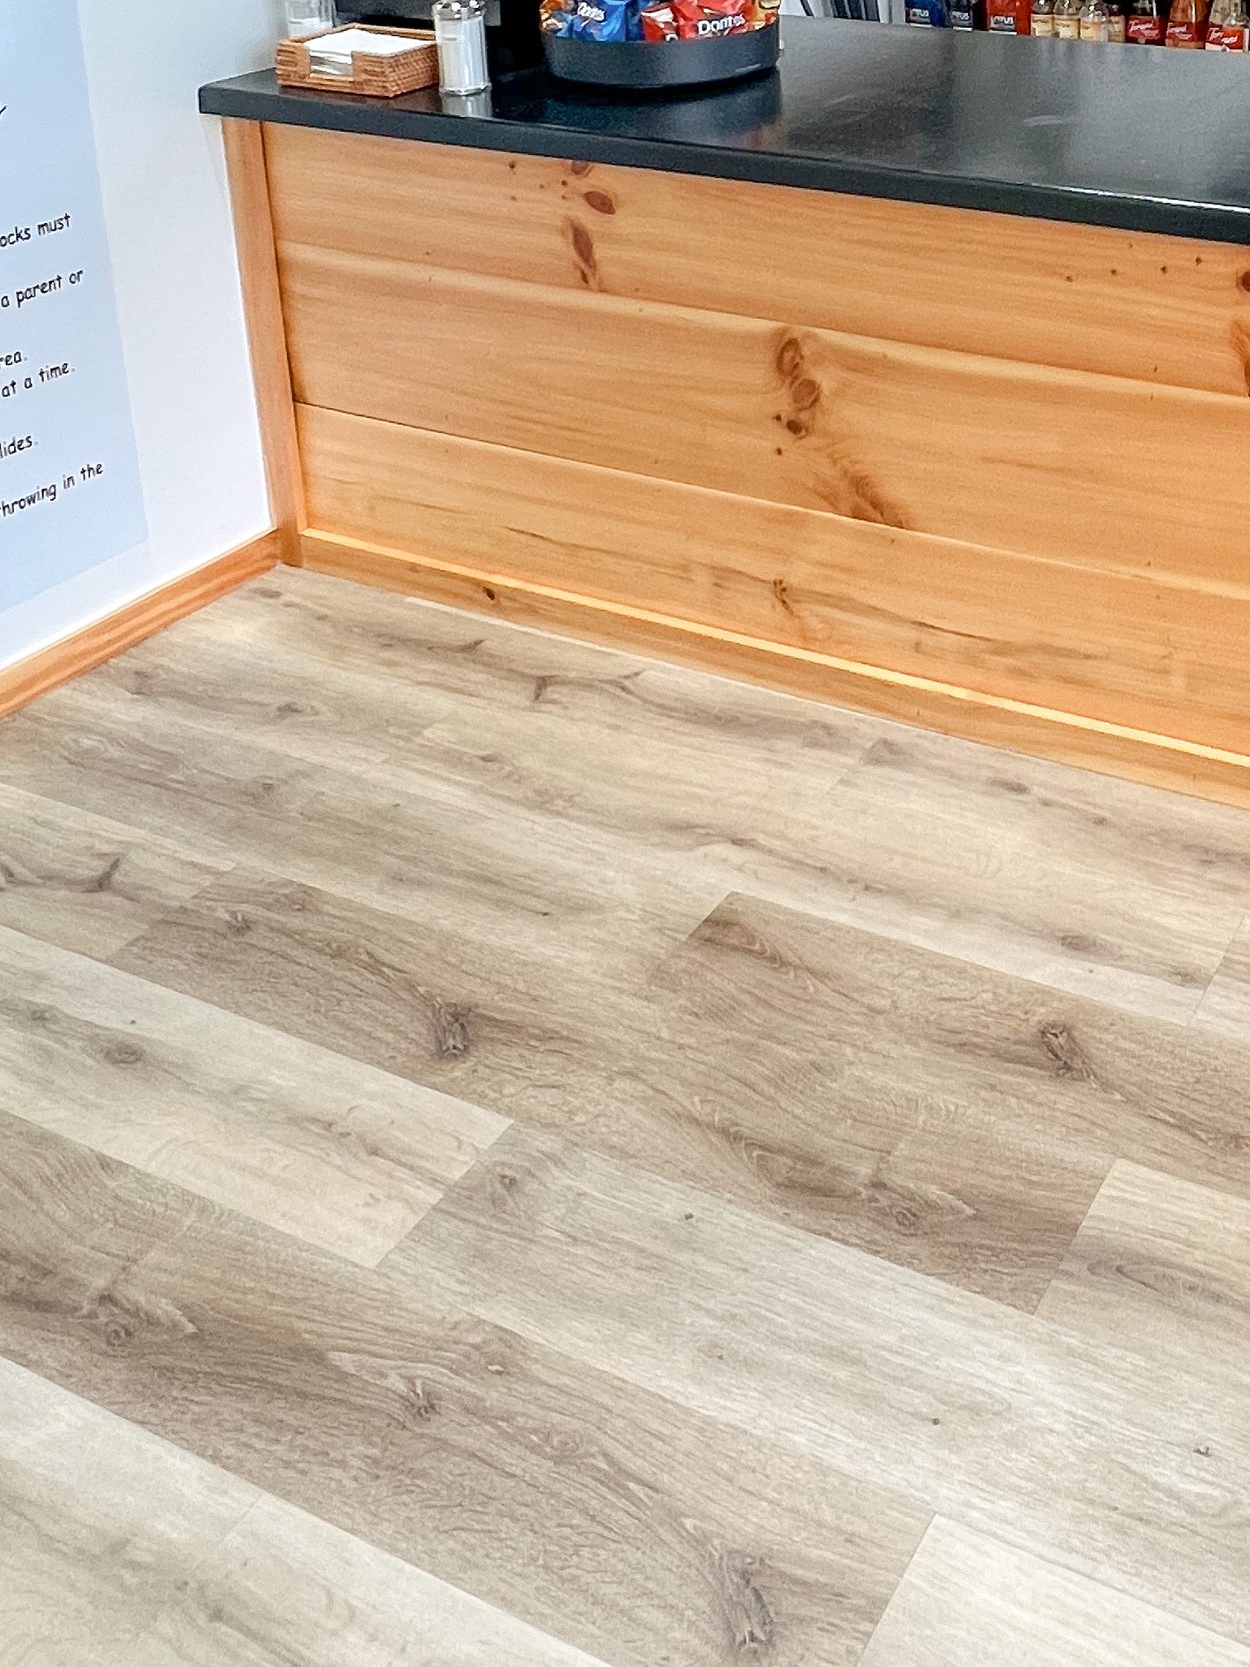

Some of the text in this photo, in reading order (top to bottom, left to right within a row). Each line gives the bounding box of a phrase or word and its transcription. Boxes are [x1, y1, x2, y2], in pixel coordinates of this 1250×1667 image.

[697, 13, 746, 35] Doritos
[37, 212, 71, 236] must
[1, 269, 84, 308] a parent or
[2, 362, 76, 398] at a time.
[0, 463, 104, 517] hrowing in the
